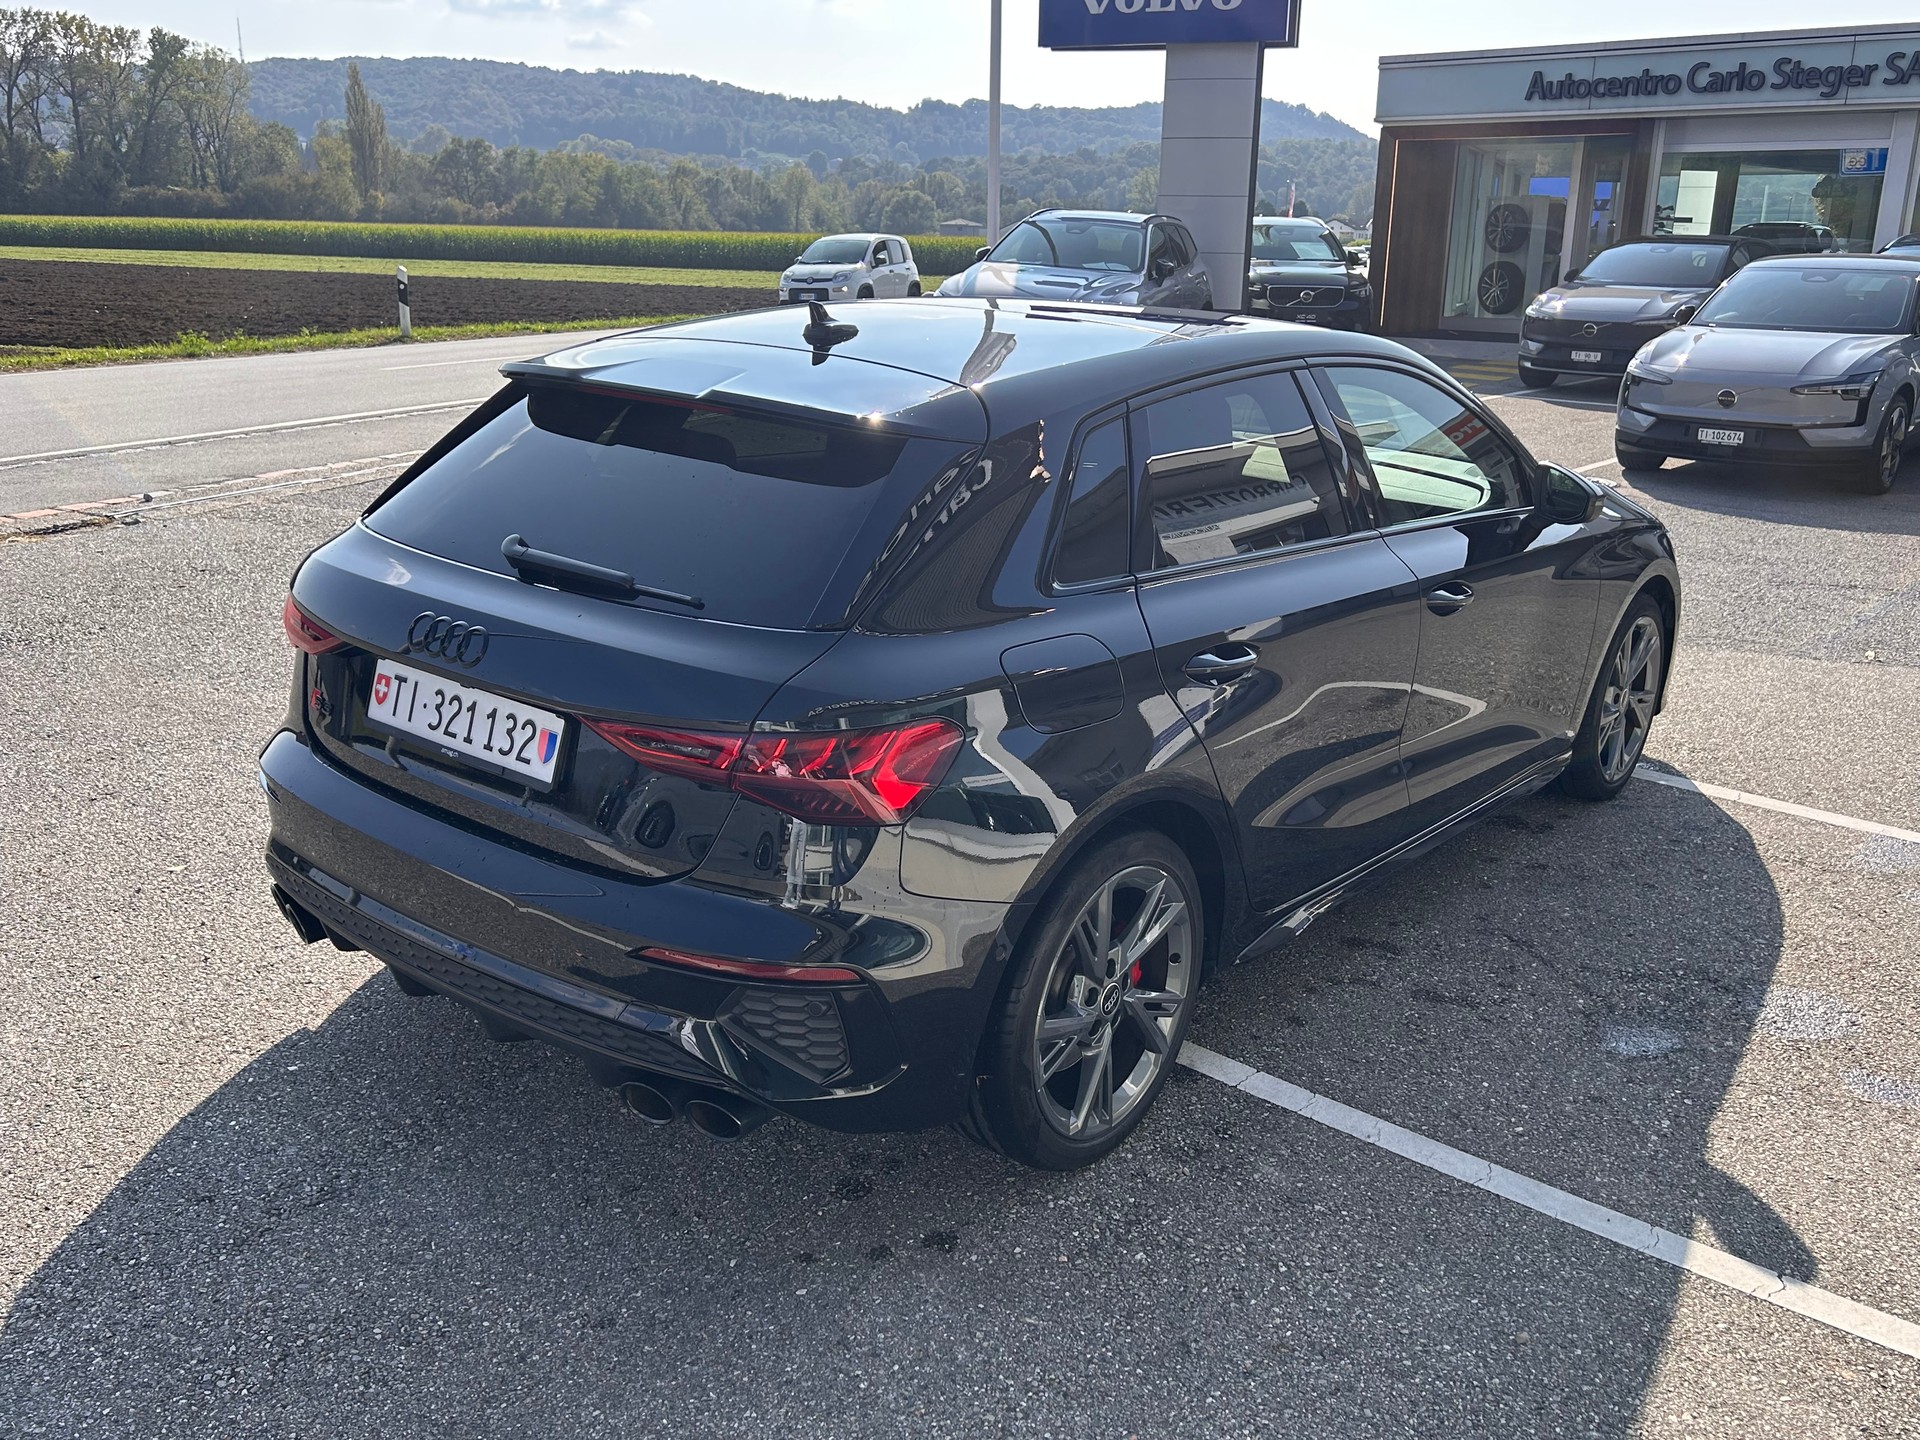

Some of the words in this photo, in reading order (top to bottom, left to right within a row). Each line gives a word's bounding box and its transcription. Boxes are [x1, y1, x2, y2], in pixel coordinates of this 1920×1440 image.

[1524, 69, 1682, 100] Autocentro
[1686, 62, 1766, 94] Carlo
[1770, 57, 1879, 97] Steger
[1883, 50, 1920, 85] SA
